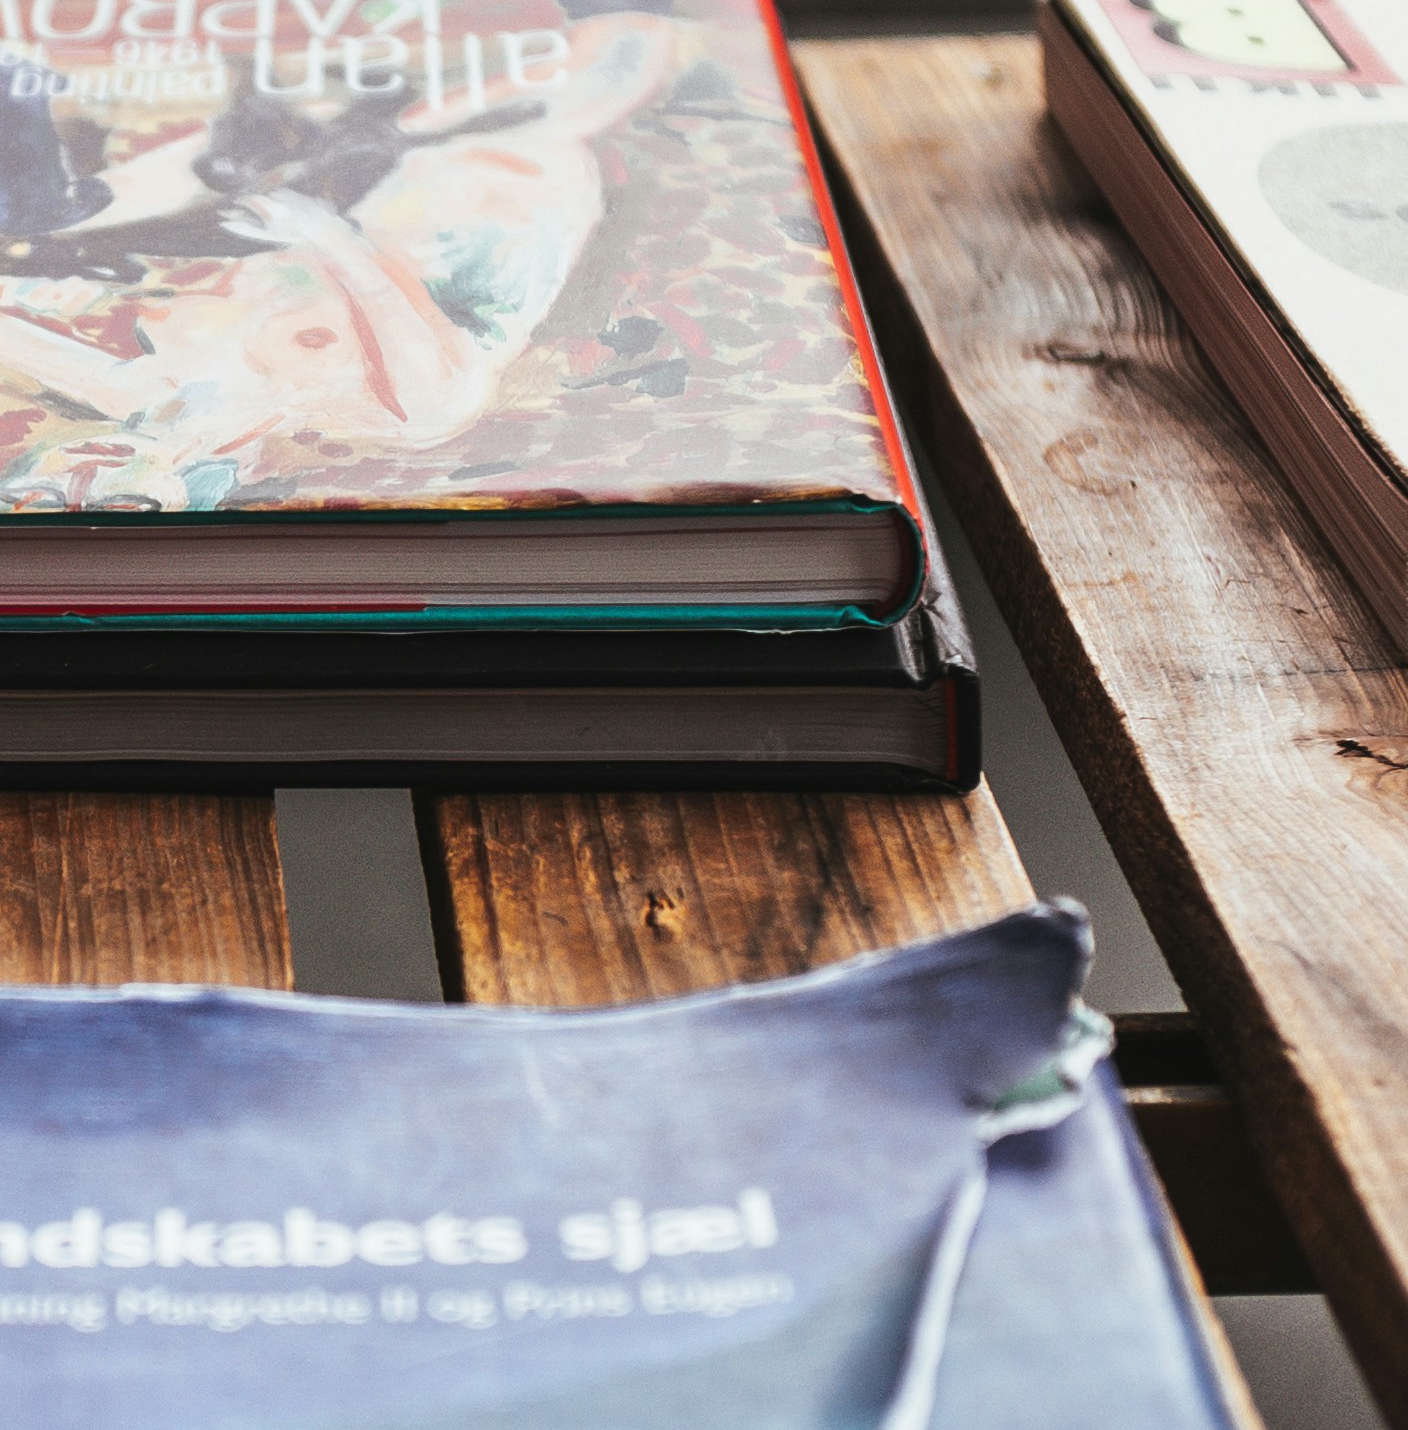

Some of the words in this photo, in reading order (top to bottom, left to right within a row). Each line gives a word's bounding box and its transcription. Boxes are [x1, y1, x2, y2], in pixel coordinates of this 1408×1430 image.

[114, 37, 224, 67] 1946
[252, 29, 570, 111] allan
[8, 64, 228, 104] painting
[558, 1187, 780, 1274] sjæl
